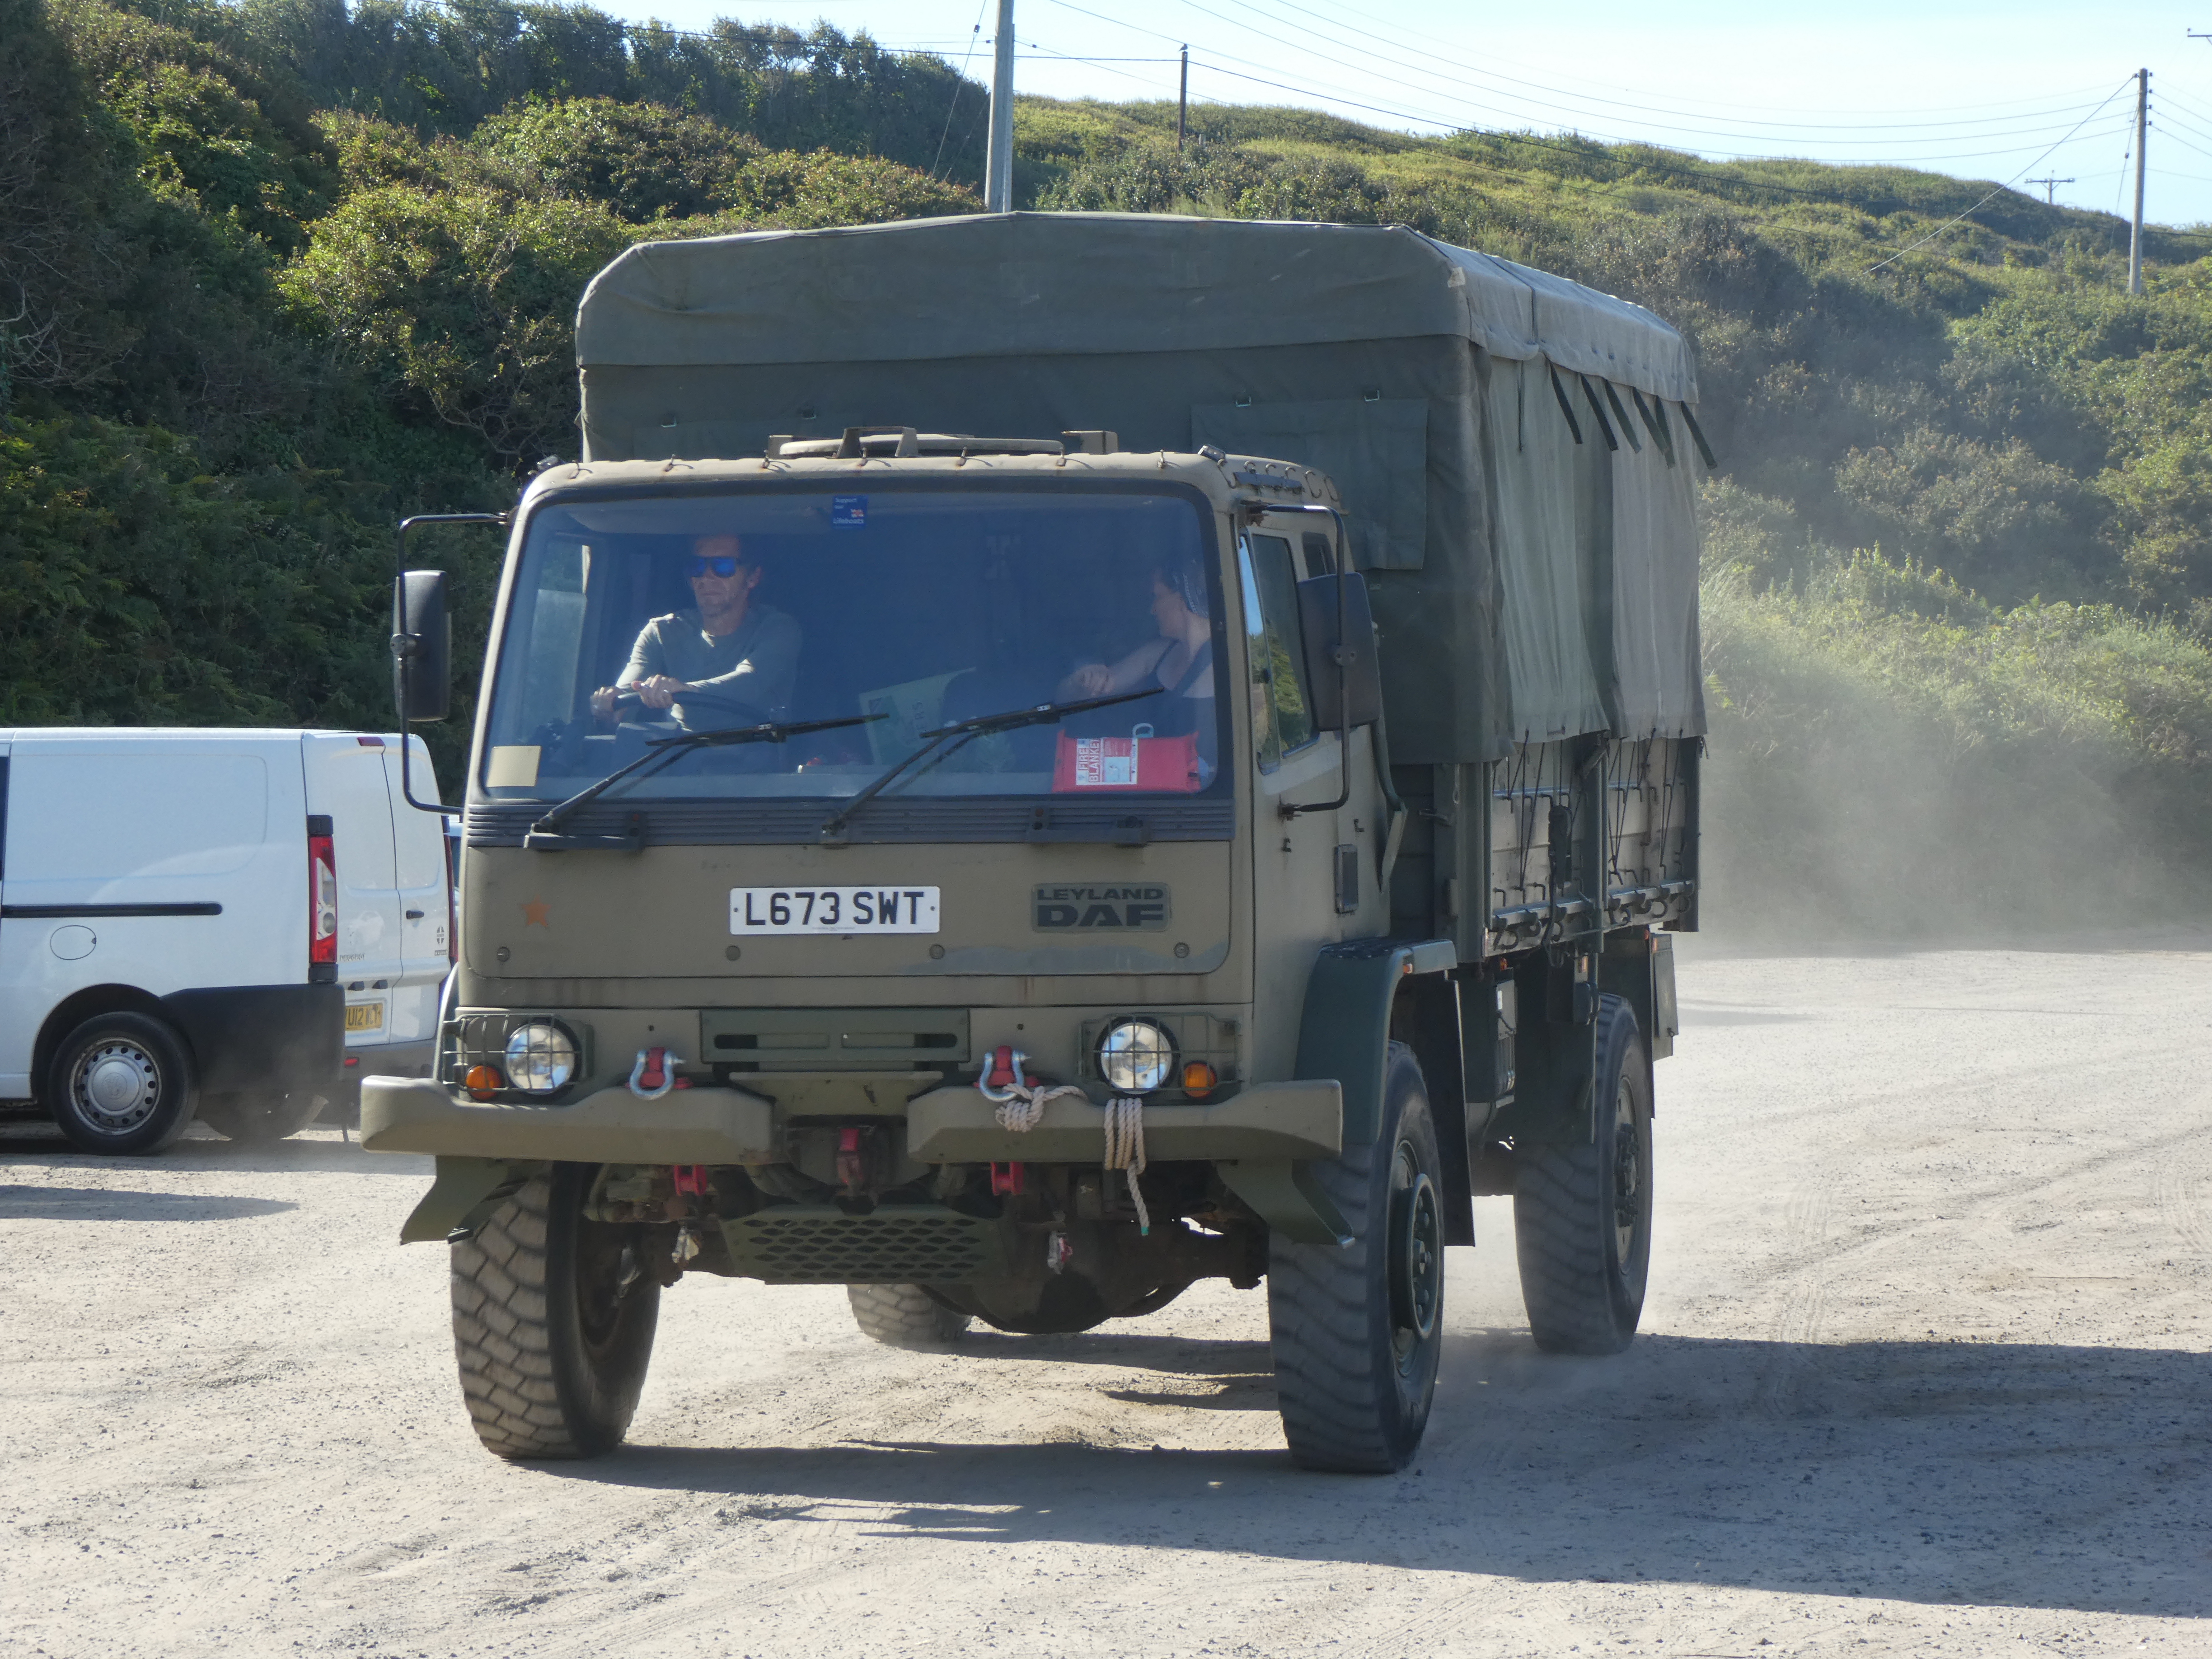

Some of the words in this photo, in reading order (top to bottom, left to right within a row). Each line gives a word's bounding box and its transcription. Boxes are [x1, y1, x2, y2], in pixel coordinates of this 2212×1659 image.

[1078, 748, 1088, 770] FIRE
[1036, 888, 1163, 900] LEYLAND
[745, 891, 840, 925] L673
[853, 891, 924, 925] SWT
[1037, 904, 1163, 927] DAF
